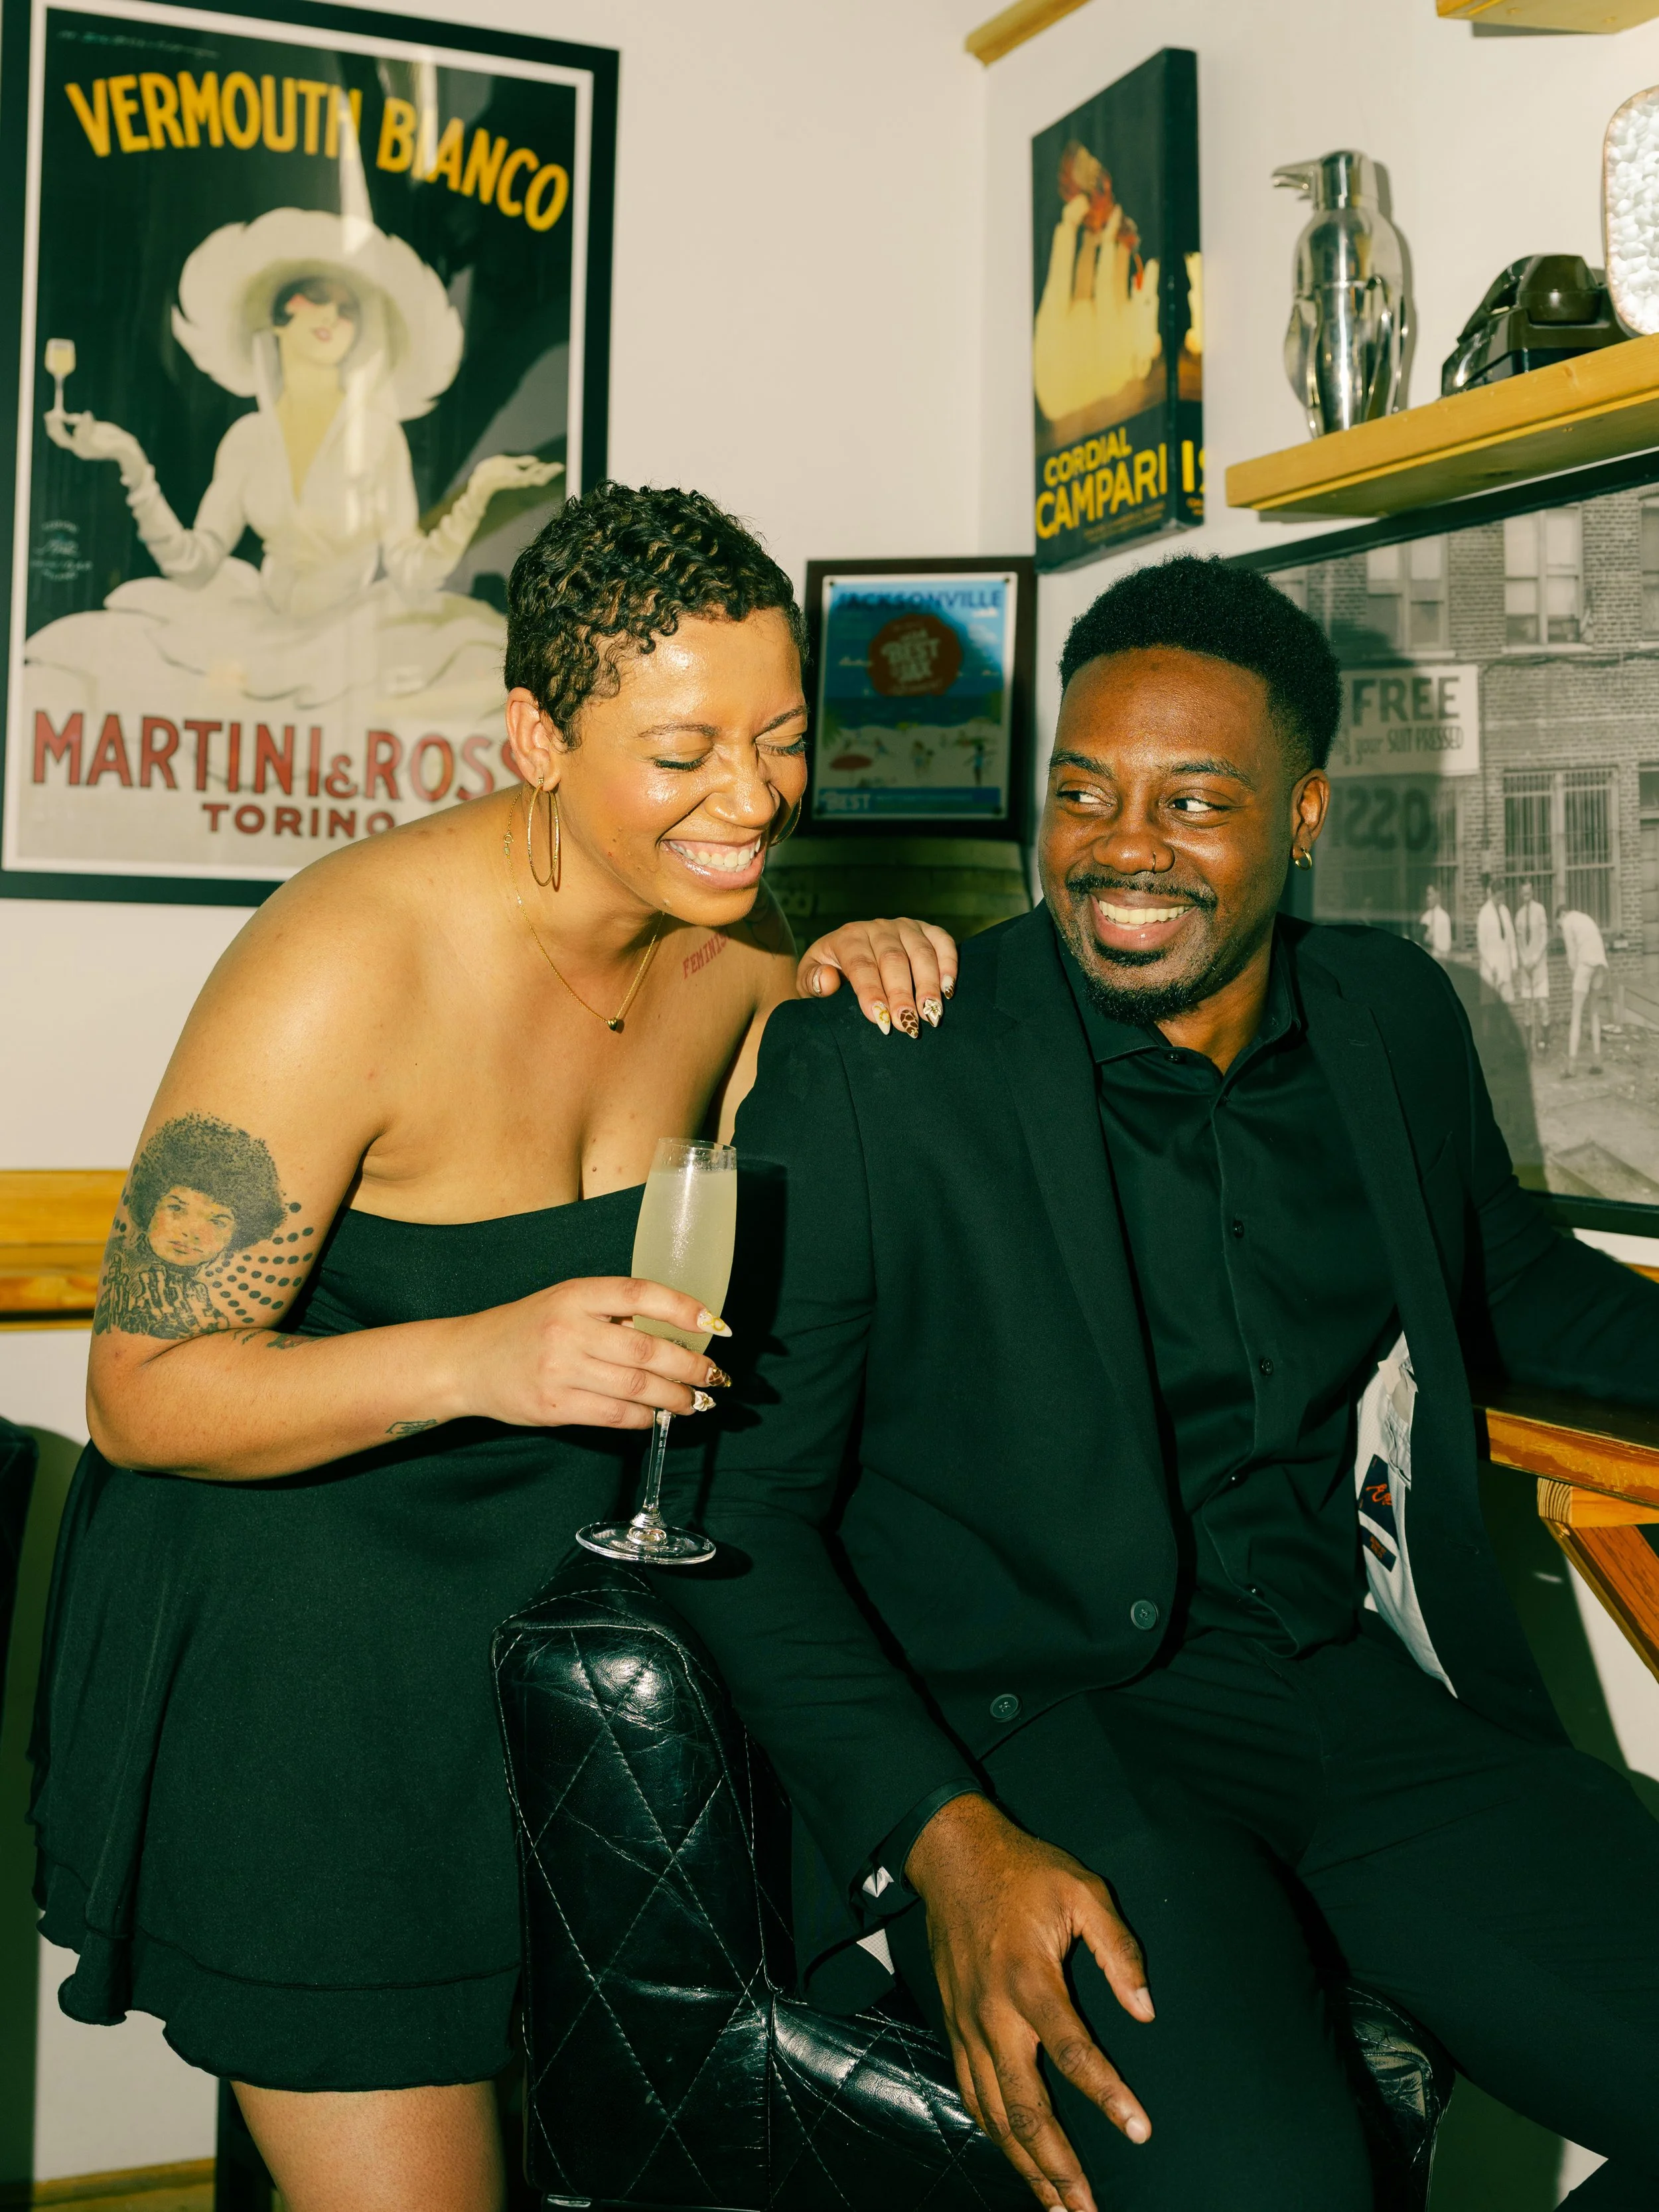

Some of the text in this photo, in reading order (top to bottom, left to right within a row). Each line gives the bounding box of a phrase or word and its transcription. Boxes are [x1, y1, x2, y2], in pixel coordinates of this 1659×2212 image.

[65, 72, 569, 232] VERMOUTH BIANCO
[1043, 425, 1133, 486] CORDIAL
[1035, 442, 1167, 540] CAMPARI
[1352, 676, 1460, 726] FREE
[202, 804, 396, 838] TORINO
